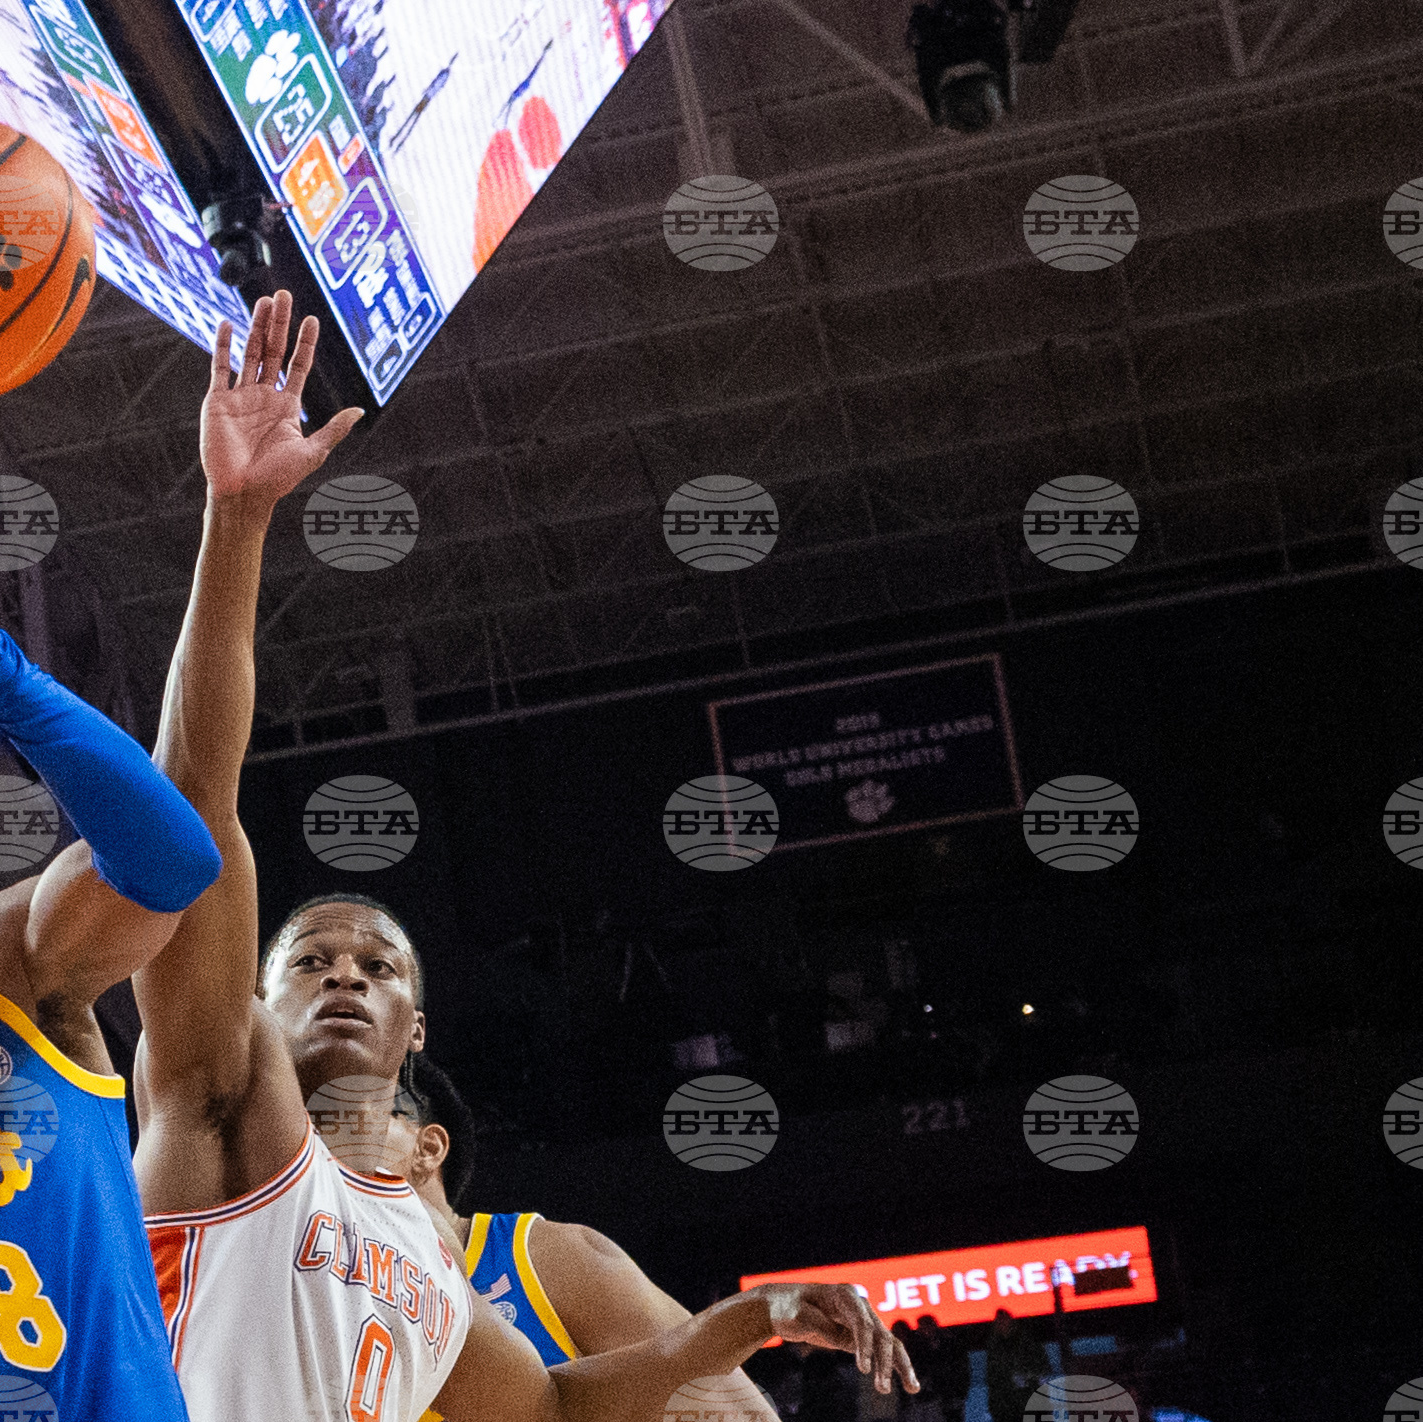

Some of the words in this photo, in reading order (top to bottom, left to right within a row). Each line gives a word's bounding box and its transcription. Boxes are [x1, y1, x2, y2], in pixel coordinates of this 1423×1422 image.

[903, 1098, 969, 1136] 221
[877, 1274, 946, 1313] JET
[953, 1269, 992, 1303] IS
